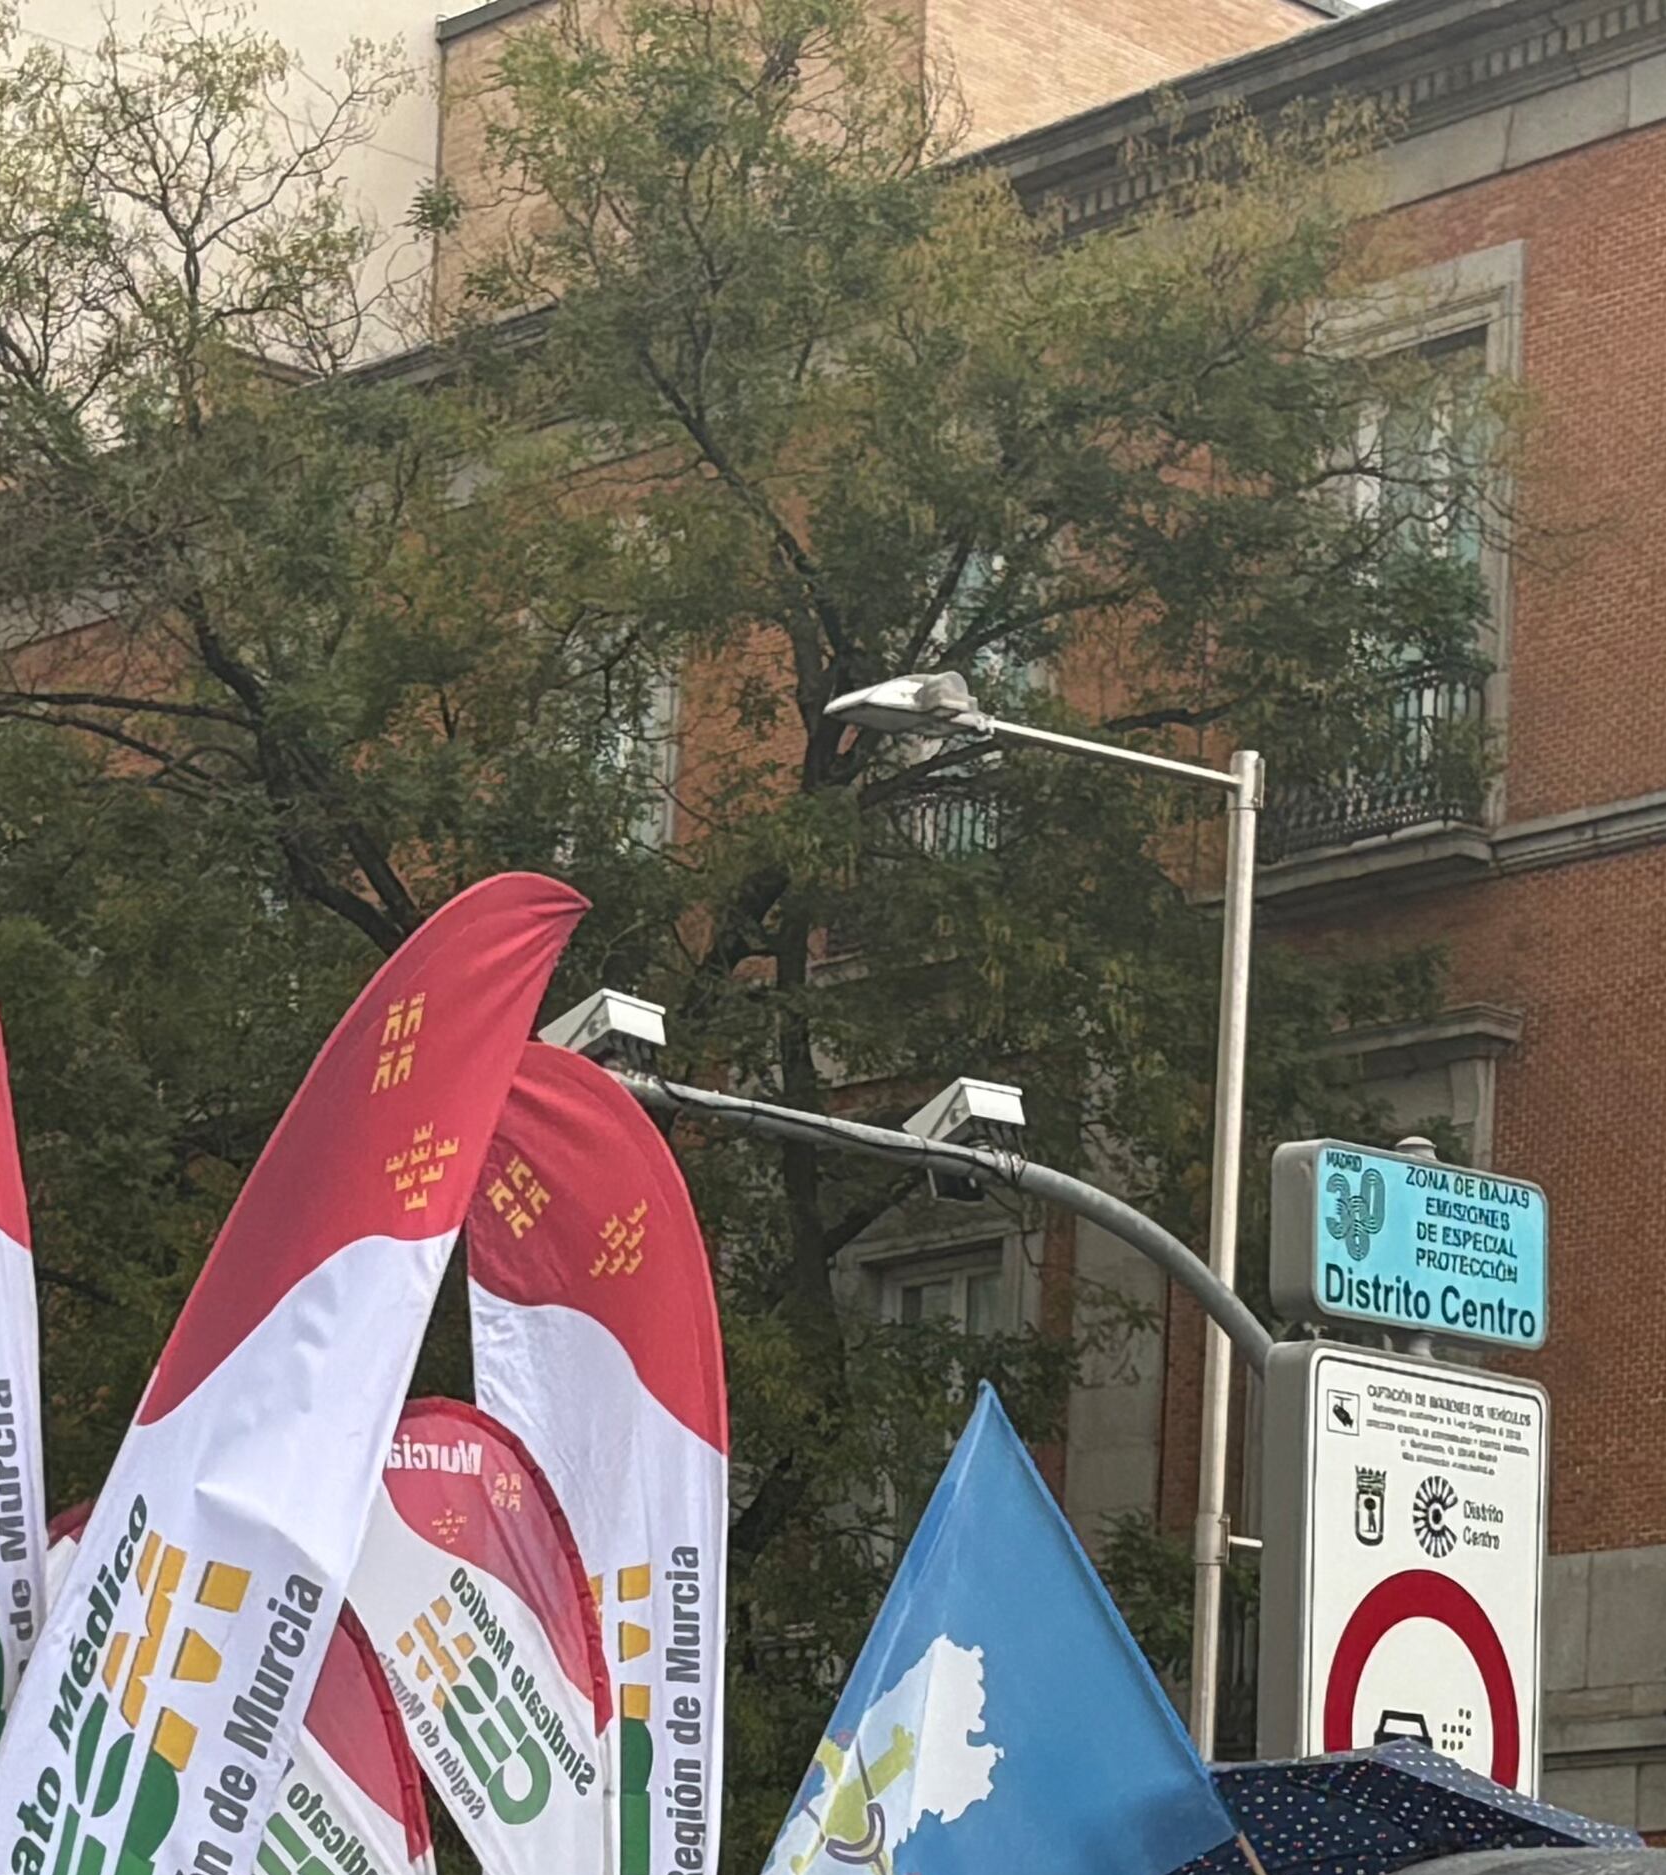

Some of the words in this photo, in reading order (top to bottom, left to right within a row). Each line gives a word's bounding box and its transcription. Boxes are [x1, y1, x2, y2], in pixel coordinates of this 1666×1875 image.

[1406, 1166, 1449, 1192] ZONA
[1453, 1175, 1475, 1198] DE
[1479, 1181, 1530, 1209] BAJAS
[1426, 1197, 1510, 1231] EMISIONES
[1417, 1222, 1437, 1242] DE
[1442, 1227, 1518, 1258] ESPECIAL
[1416, 1248, 1518, 1283] PROTECCIÓN
[1325, 1262, 1430, 1319] Distrito
[1441, 1285, 1536, 1338] Centro
[1463, 1500, 1504, 1523] Distrito
[1463, 1526, 1500, 1550] Centro
[49, 1495, 148, 1753] Médico
[667, 1546, 700, 1683] Murcia
[225, 1573, 323, 1759] Murcia
[666, 1695, 701, 1745] de
[204, 1768, 257, 1839] de
